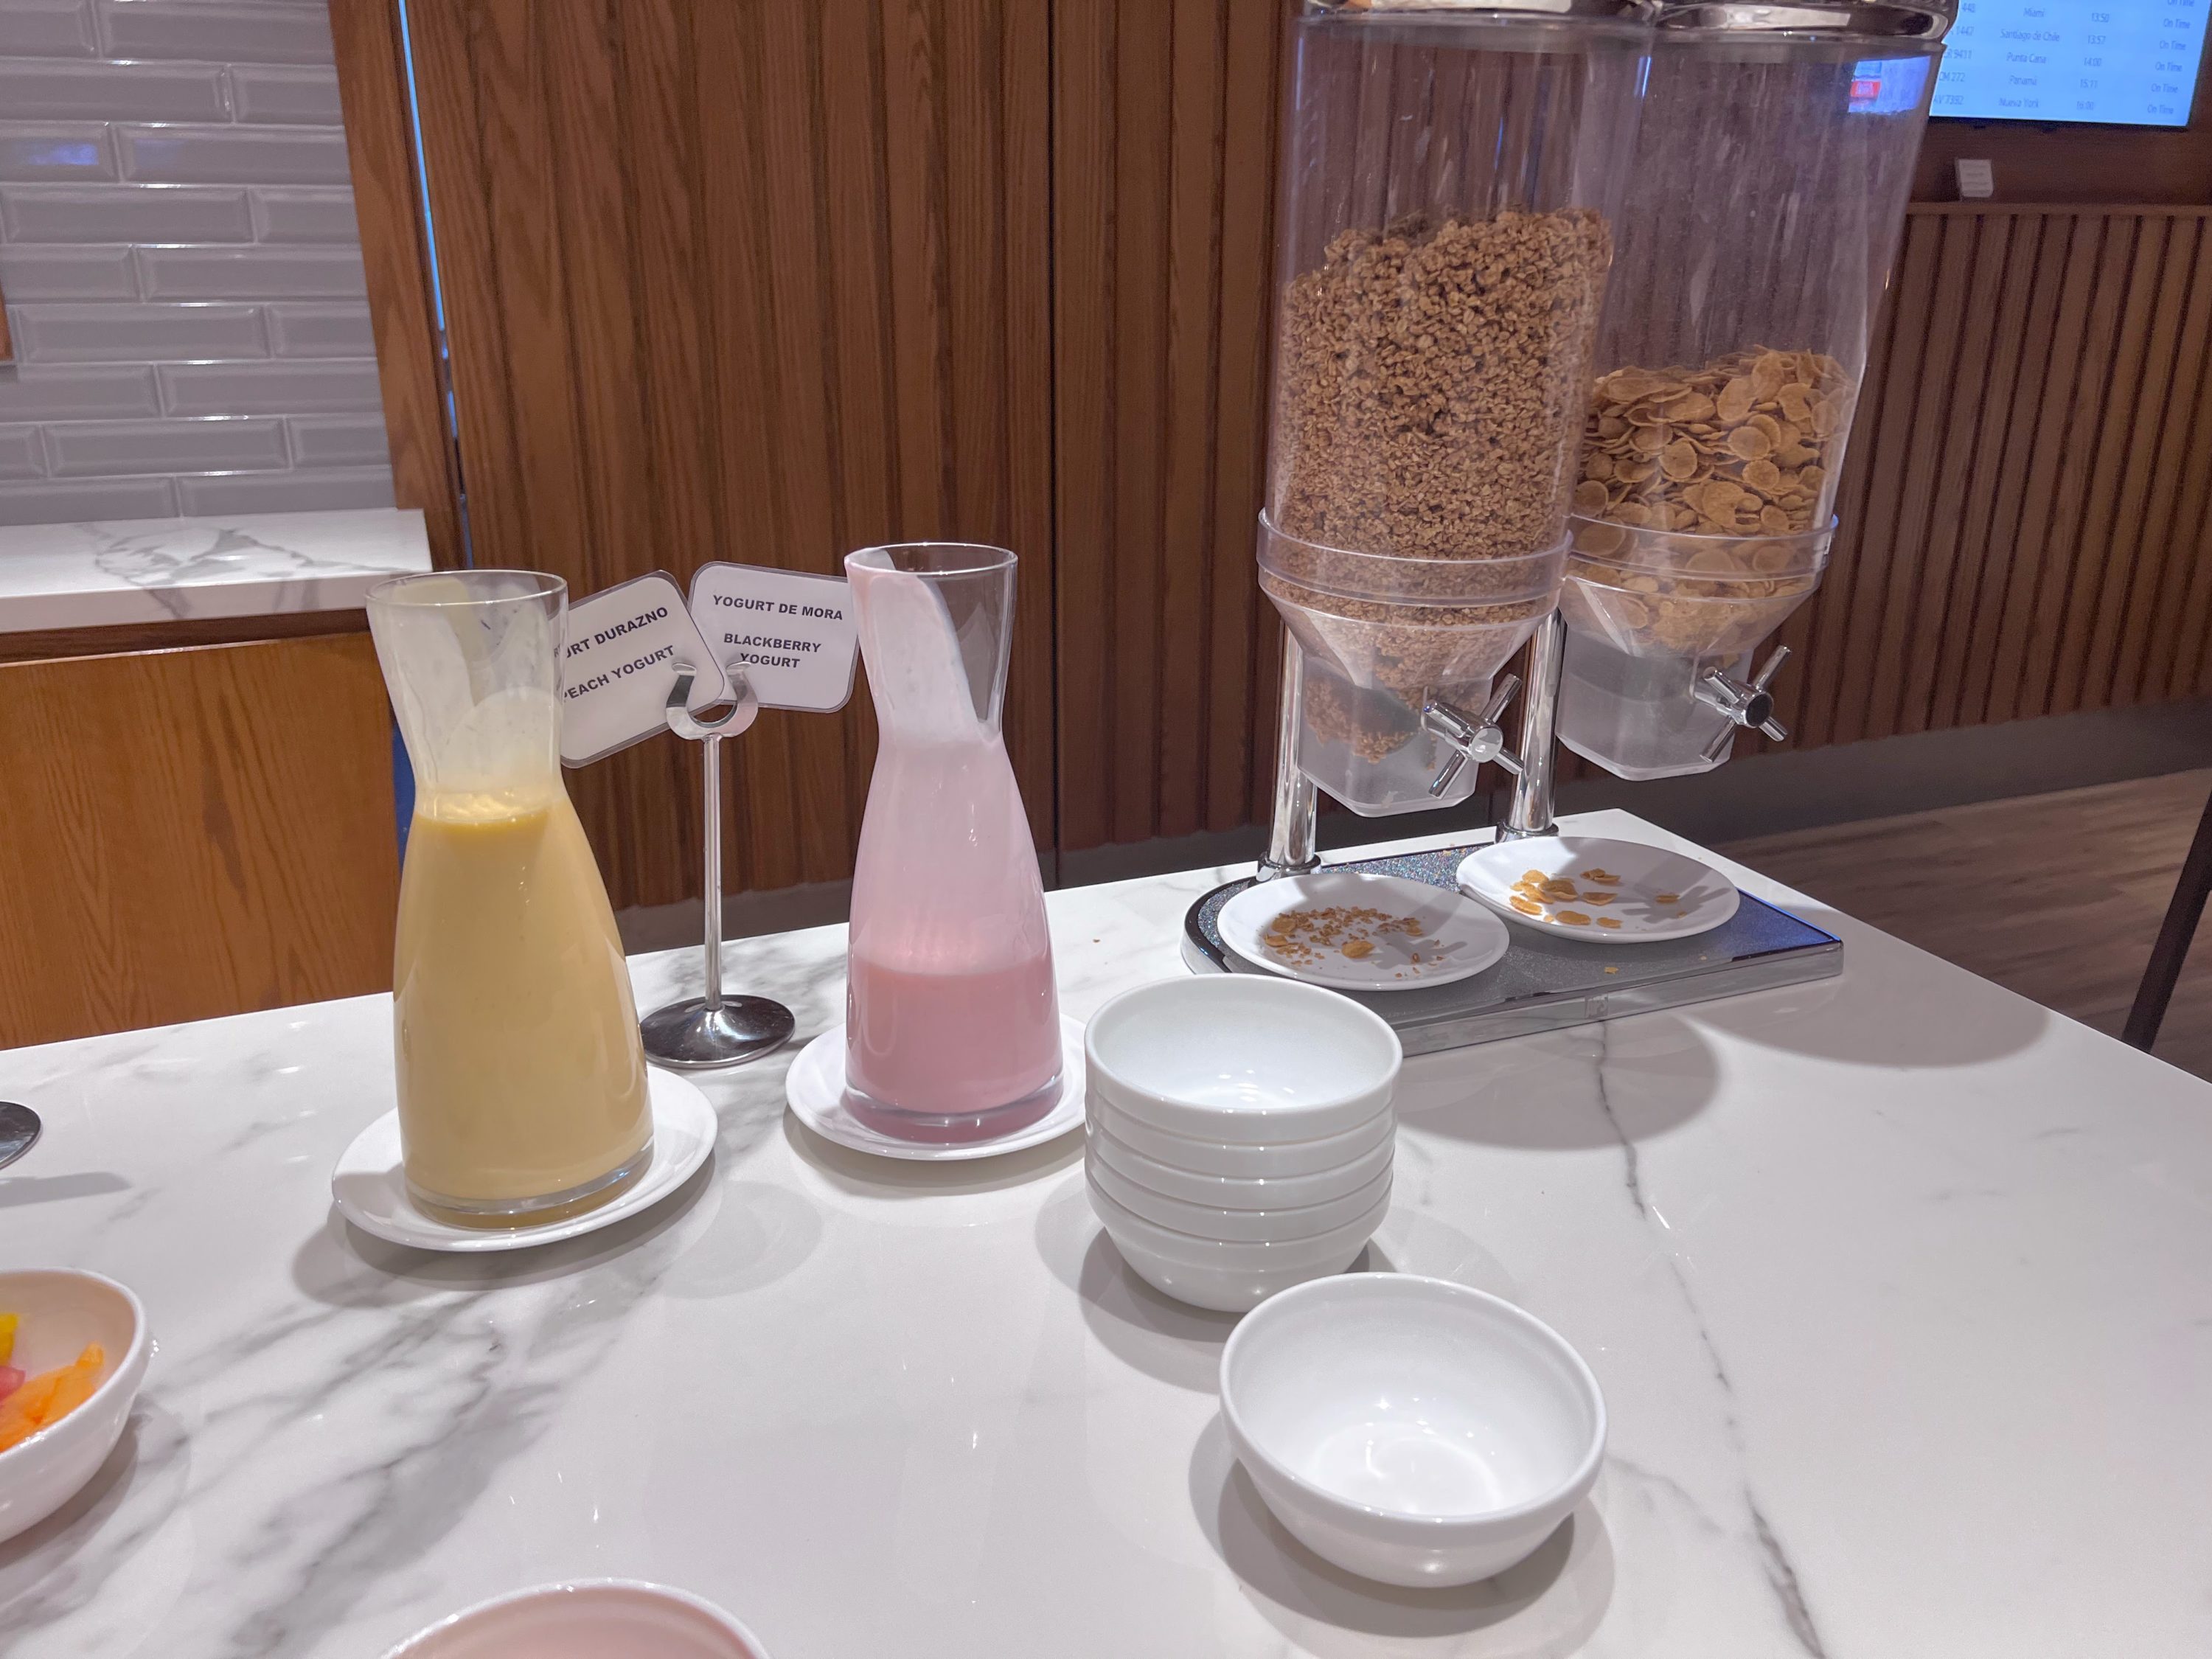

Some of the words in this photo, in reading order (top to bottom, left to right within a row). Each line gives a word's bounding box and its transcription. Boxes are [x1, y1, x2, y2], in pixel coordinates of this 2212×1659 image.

[2023, 7, 2045, 18] Miami
[2163, 18, 2174, 28] On
[2175, 18, 2191, 29] Time
[2000, 28, 2031, 41] Santiago
[2033, 30, 2042, 41] de
[2042, 30, 2060, 42] Chile
[2159, 40, 2169, 49] On
[2171, 41, 2187, 51] Time
[2006, 51, 2027, 63] Punta
[2029, 53, 2047, 64] Cana
[2155, 61, 2166, 71] On
[2166, 61, 2183, 72] Time
[2151, 83, 2161, 92] On
[2163, 83, 2178, 94] Time
[1999, 97, 2022, 108] Nueva
[2023, 97, 2039, 108] York
[2147, 104, 2157, 114] On
[2159, 104, 2174, 114] Time
[713, 594, 775, 612] YOGURT
[779, 604, 797, 615] DE
[801, 605, 843, 620] MORA
[594, 607, 668, 644] DURAZNO
[724, 633, 821, 653] BLACKBERRY
[611, 645, 675, 679] YOGURT
[740, 653, 801, 669] YOGURT
